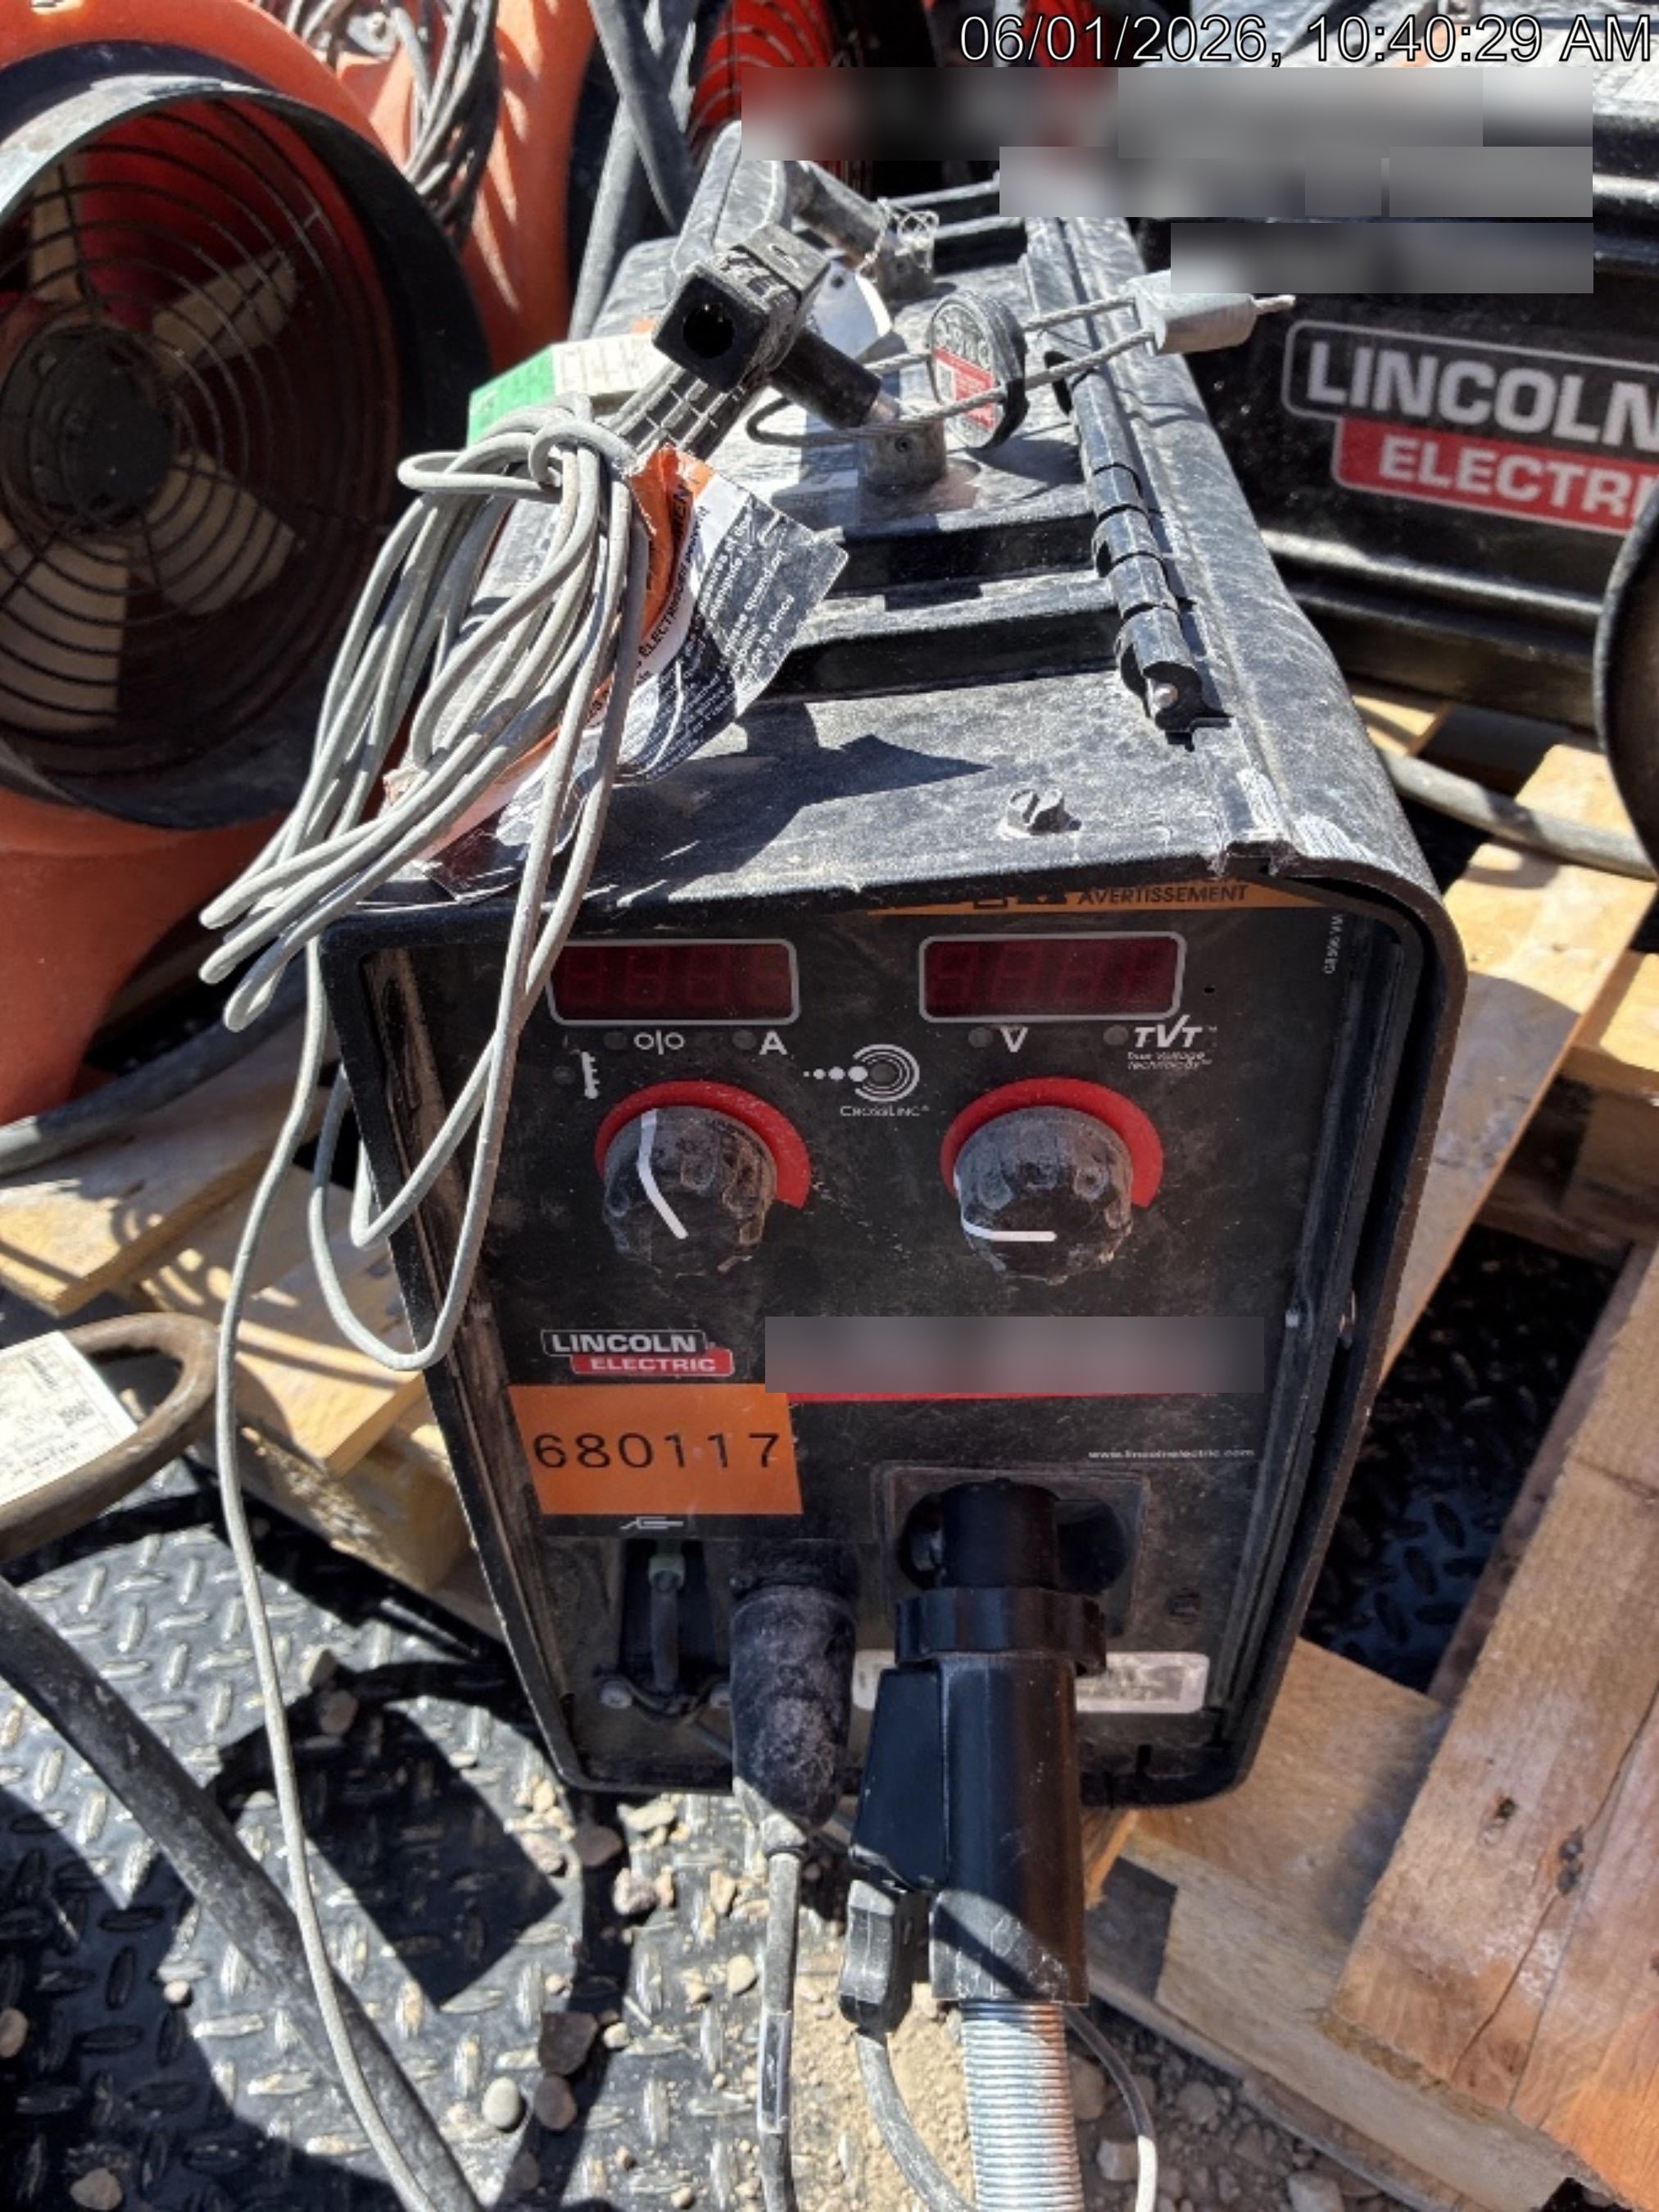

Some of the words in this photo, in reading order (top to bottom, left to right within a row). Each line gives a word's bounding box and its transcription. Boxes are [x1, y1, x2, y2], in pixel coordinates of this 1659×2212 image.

[1306, 341, 1659, 452] LINCOLN
[1077, 884, 1249, 906] AVERTISSEMENT
[759, 1030, 787, 1055] A
[999, 1027, 1029, 1053] V
[551, 1333, 696, 1353] LINCOLN
[590, 1358, 716, 1372] ELECTRIC
[533, 1432, 779, 1469] 680117
